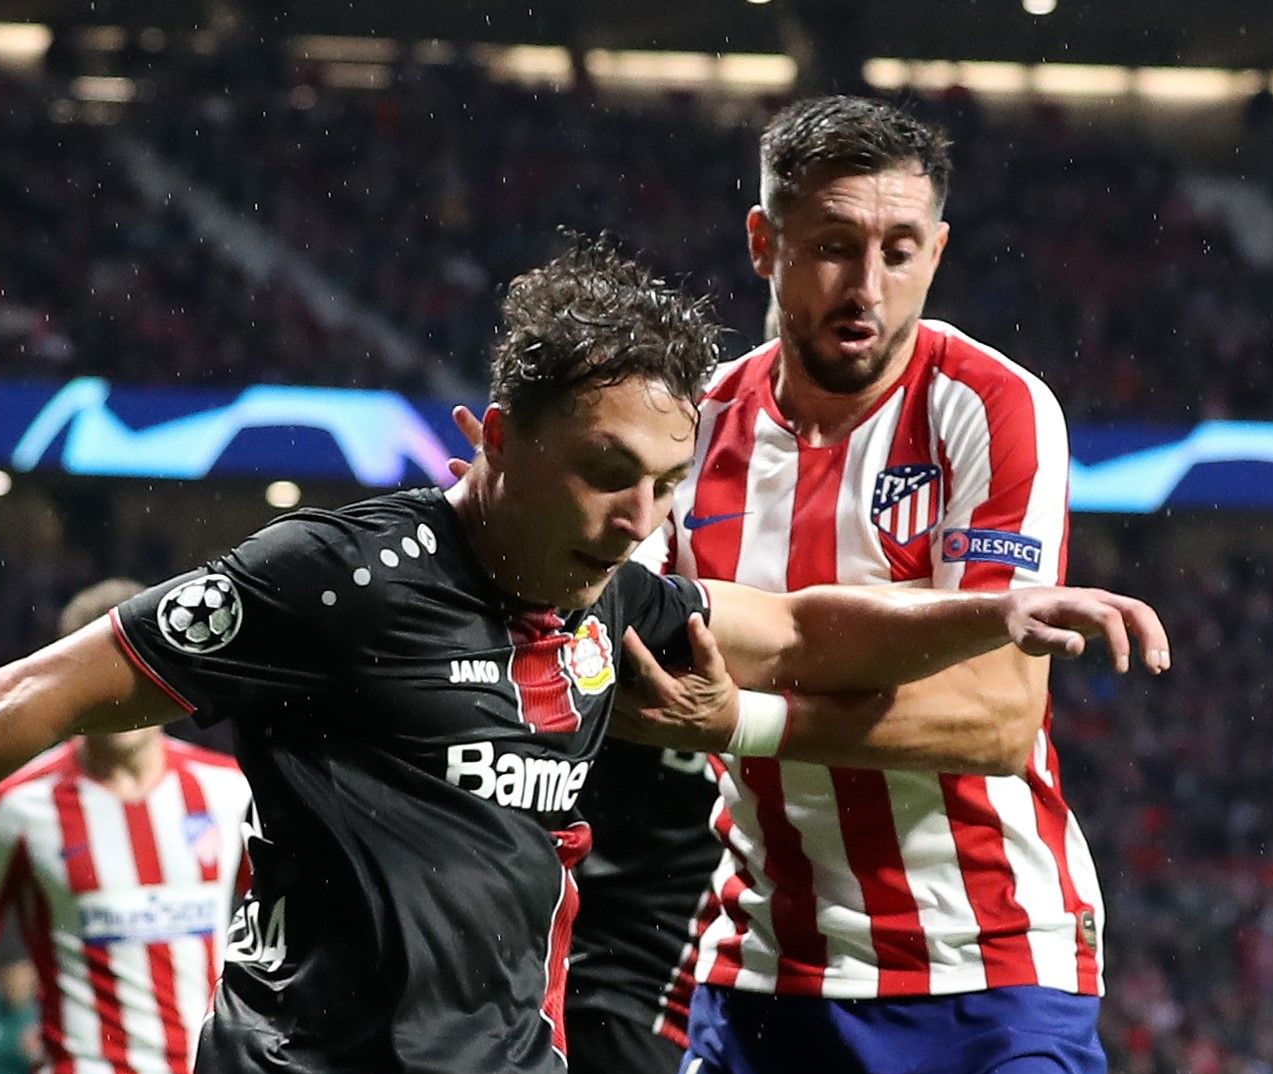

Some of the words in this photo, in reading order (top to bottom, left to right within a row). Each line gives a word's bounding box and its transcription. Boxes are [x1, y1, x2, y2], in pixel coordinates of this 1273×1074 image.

[970, 538, 1041, 564] RESPECT
[449, 660, 500, 684] JAKO
[445, 741, 593, 812] Barme
